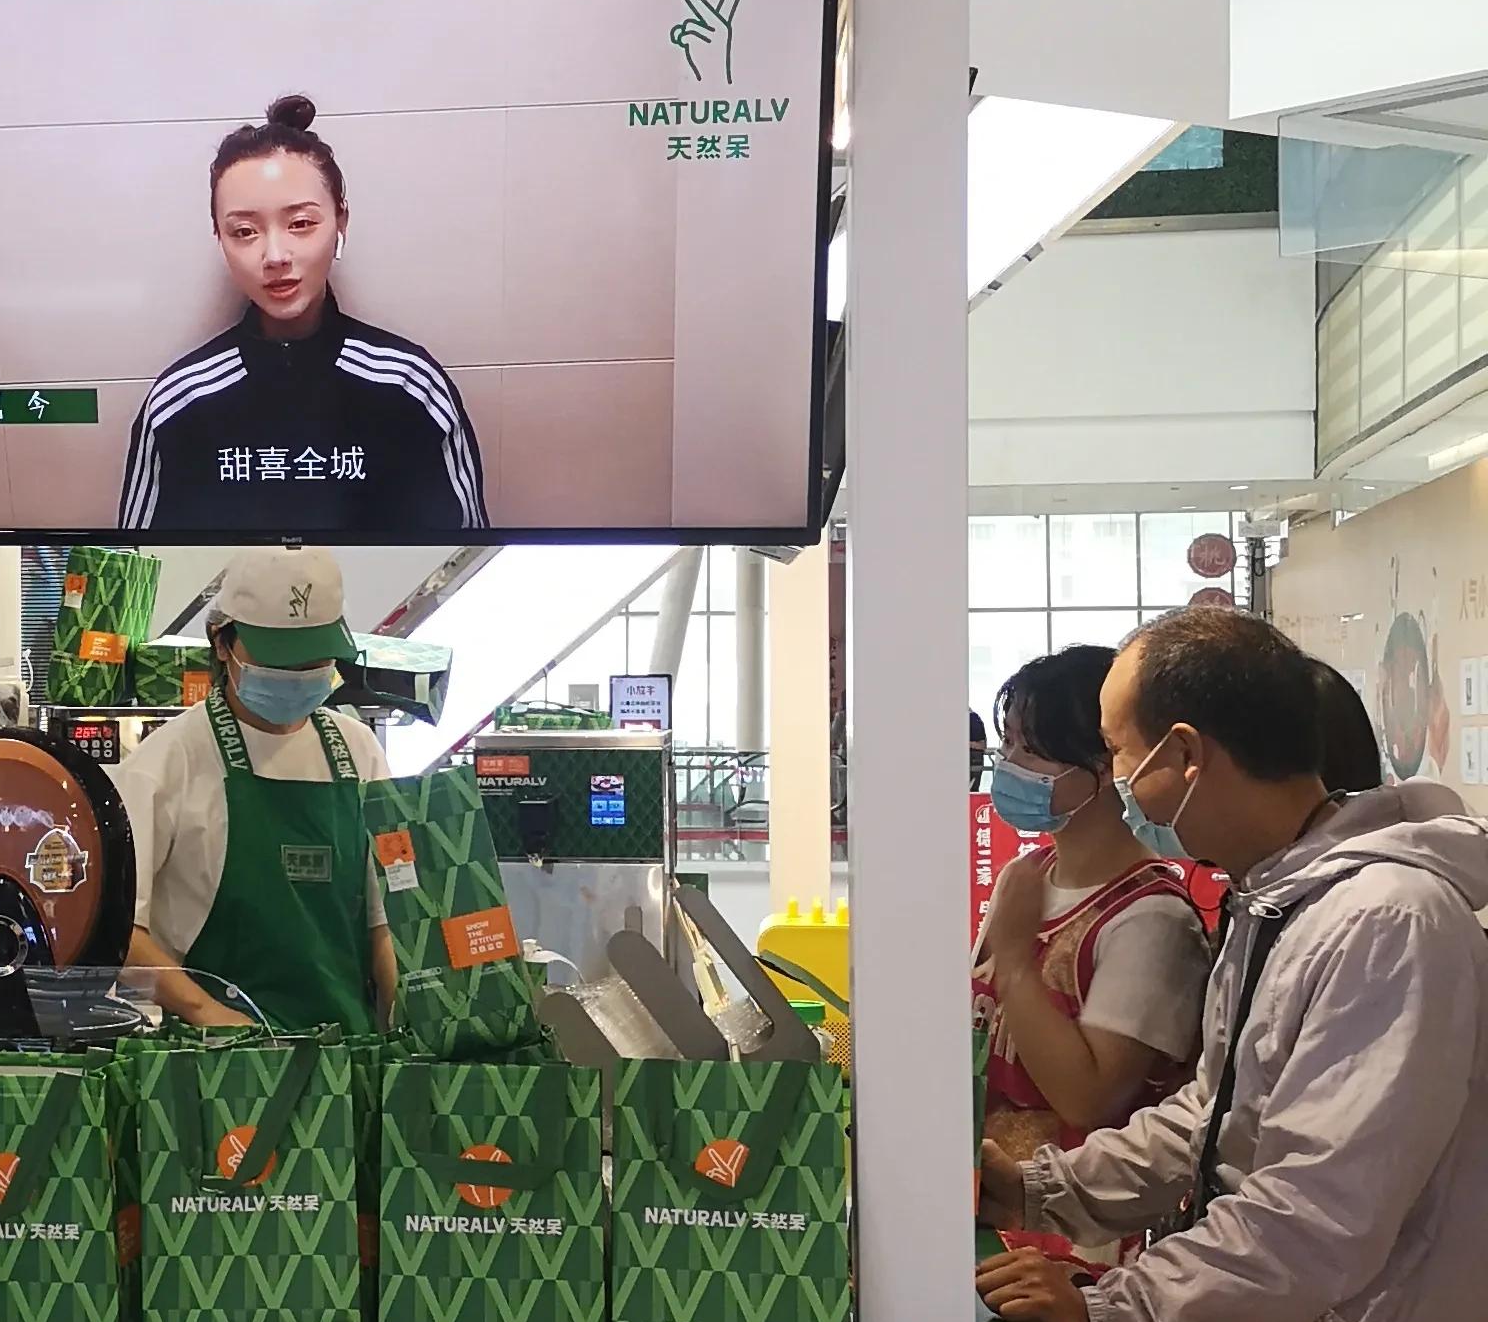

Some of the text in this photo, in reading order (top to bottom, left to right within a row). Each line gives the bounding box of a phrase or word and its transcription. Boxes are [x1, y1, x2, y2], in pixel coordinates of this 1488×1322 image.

[629, 97, 790, 126] NATURALV
[667, 134, 750, 161] 天然呆
[218, 446, 368, 482] 甜喜全城
[170, 1193, 319, 1214] NATURALV 天然呆
[406, 1214, 563, 1236] NATURALV 天然呆
[645, 1207, 806, 1231] NATURALV 天然呆
[30, 1222, 80, 1241] 天然呆
